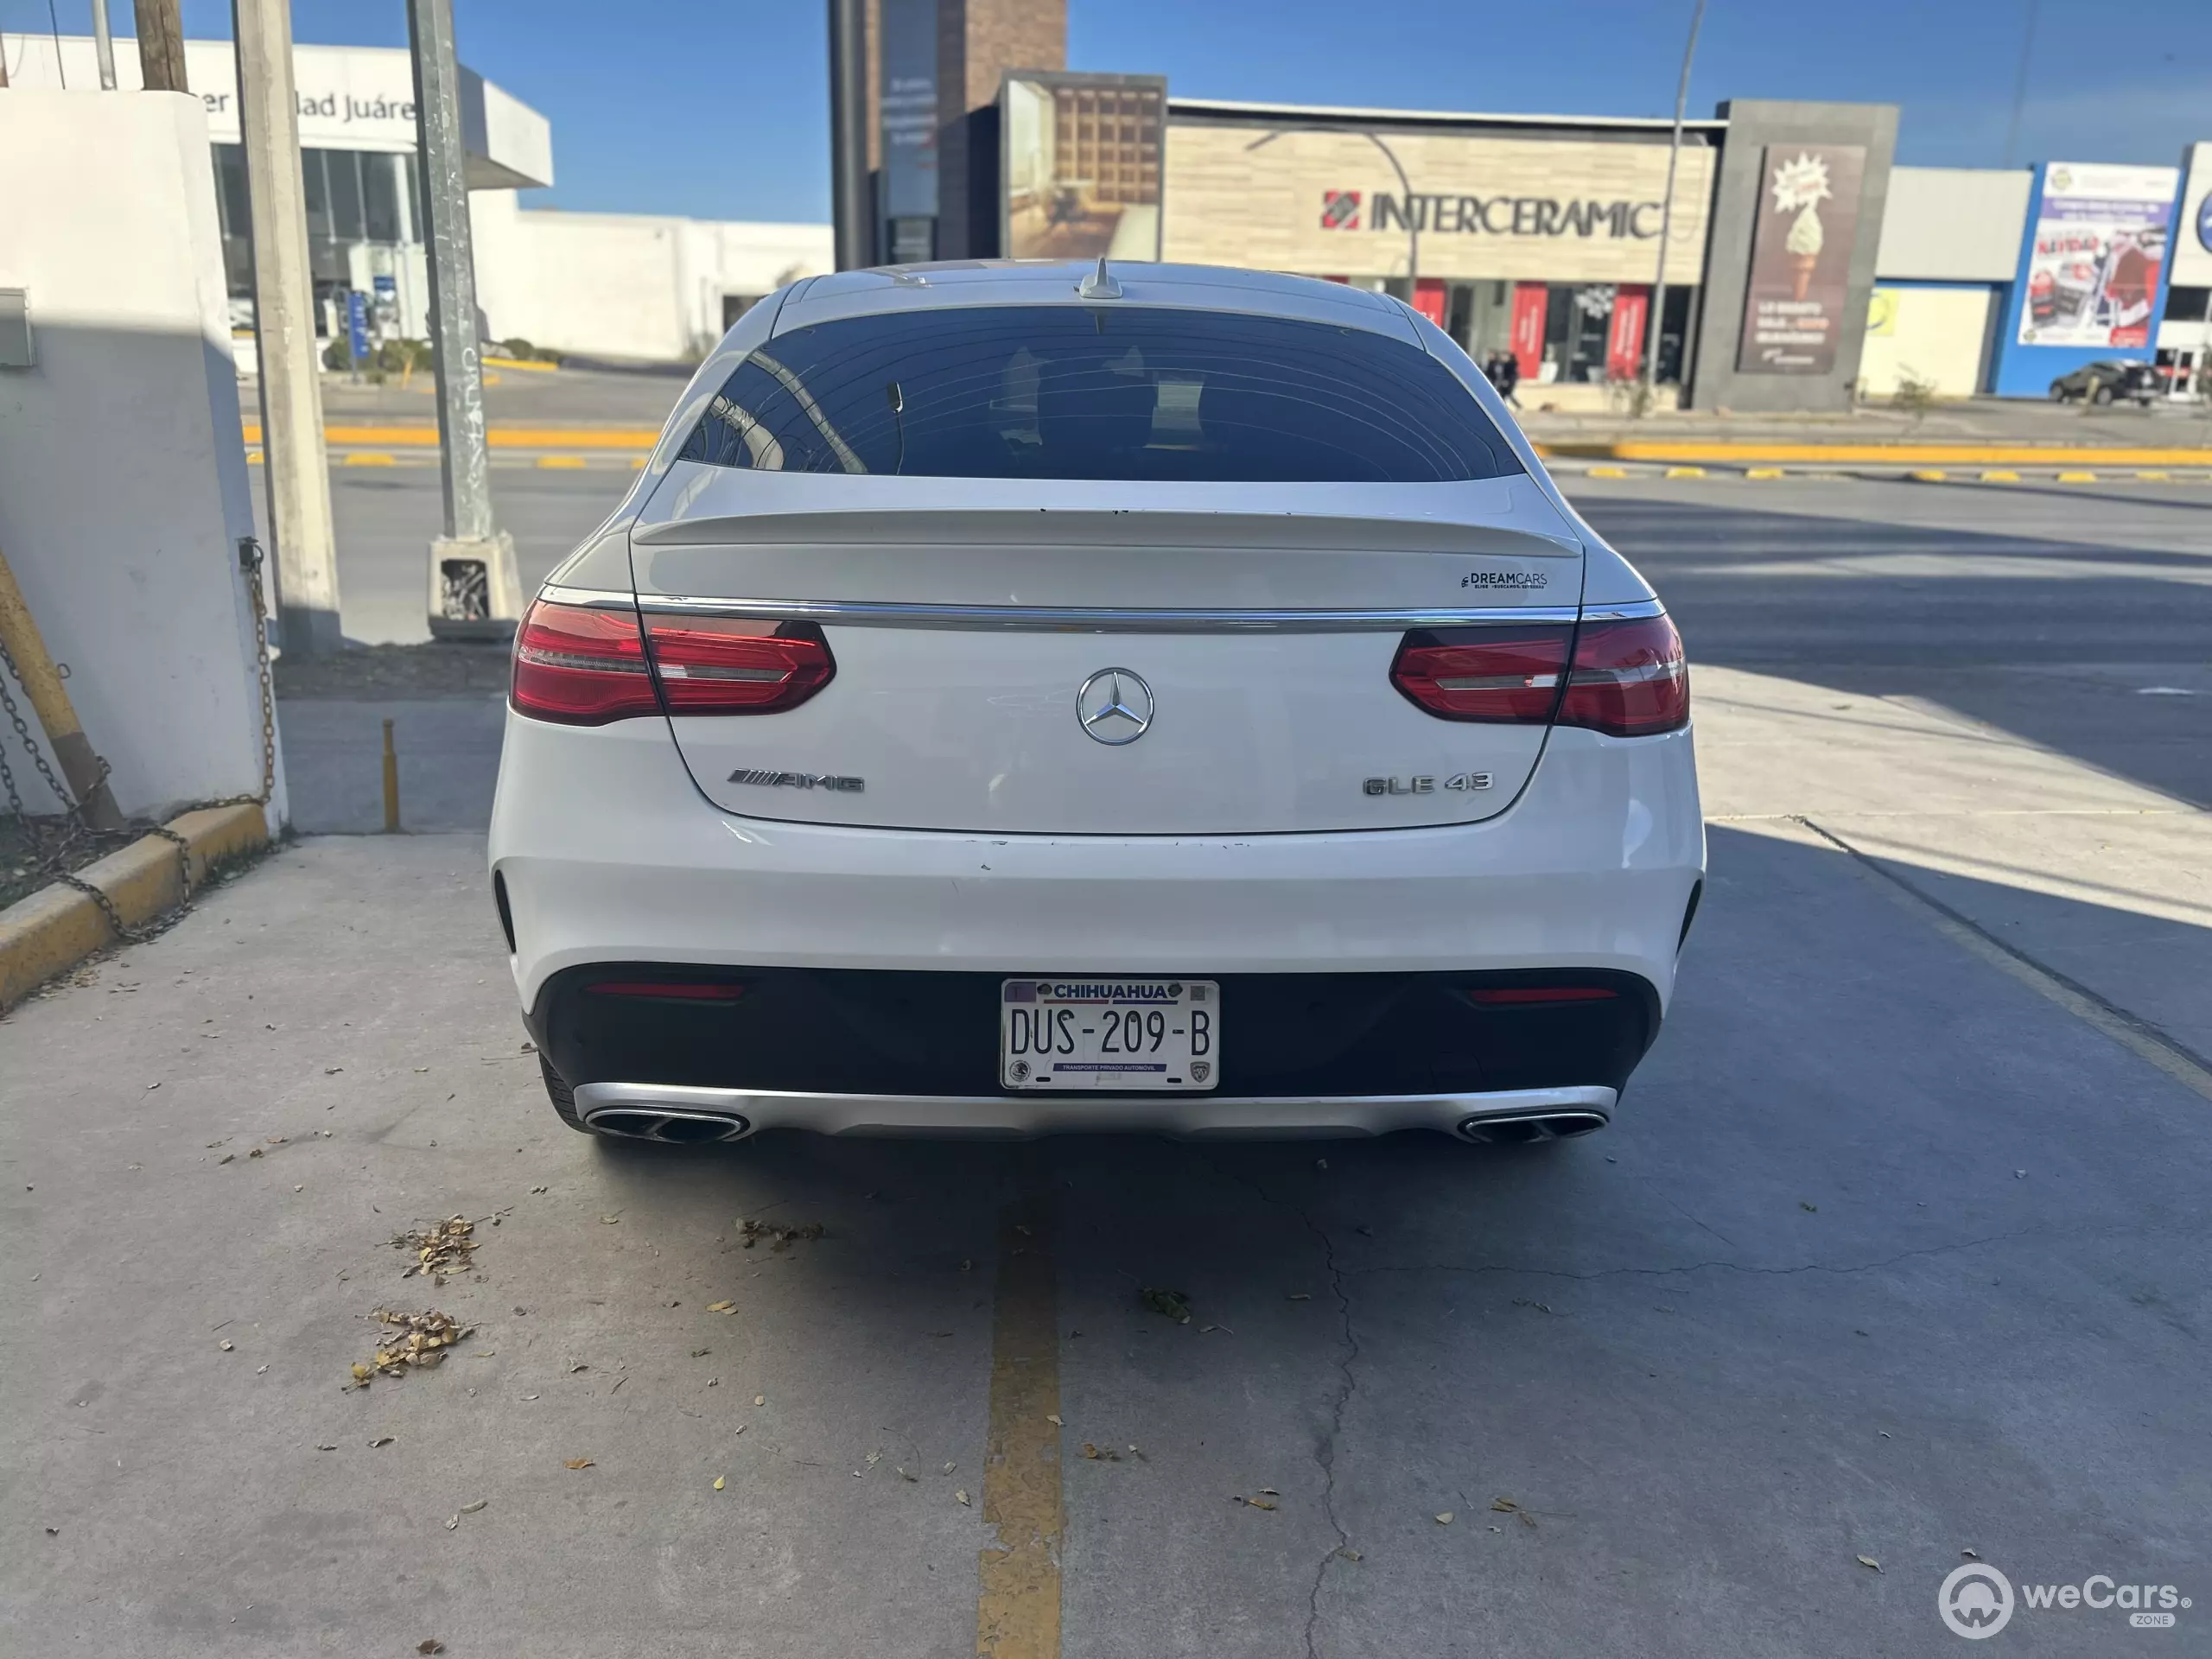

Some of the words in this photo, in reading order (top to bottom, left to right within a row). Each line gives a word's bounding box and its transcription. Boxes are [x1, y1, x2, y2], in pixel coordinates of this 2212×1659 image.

[343, 91, 416, 124] Juáre
[1370, 191, 1668, 239] INTERCERAMIC
[1471, 572, 1548, 585] DREAMCARS
[775, 771, 865, 792] AMG
[1363, 776, 1436, 795] GLE
[1444, 772, 1495, 791] 43
[1053, 984, 1168, 999] CHIHUAHUA
[1011, 1008, 1211, 1056] DUS-209-B
